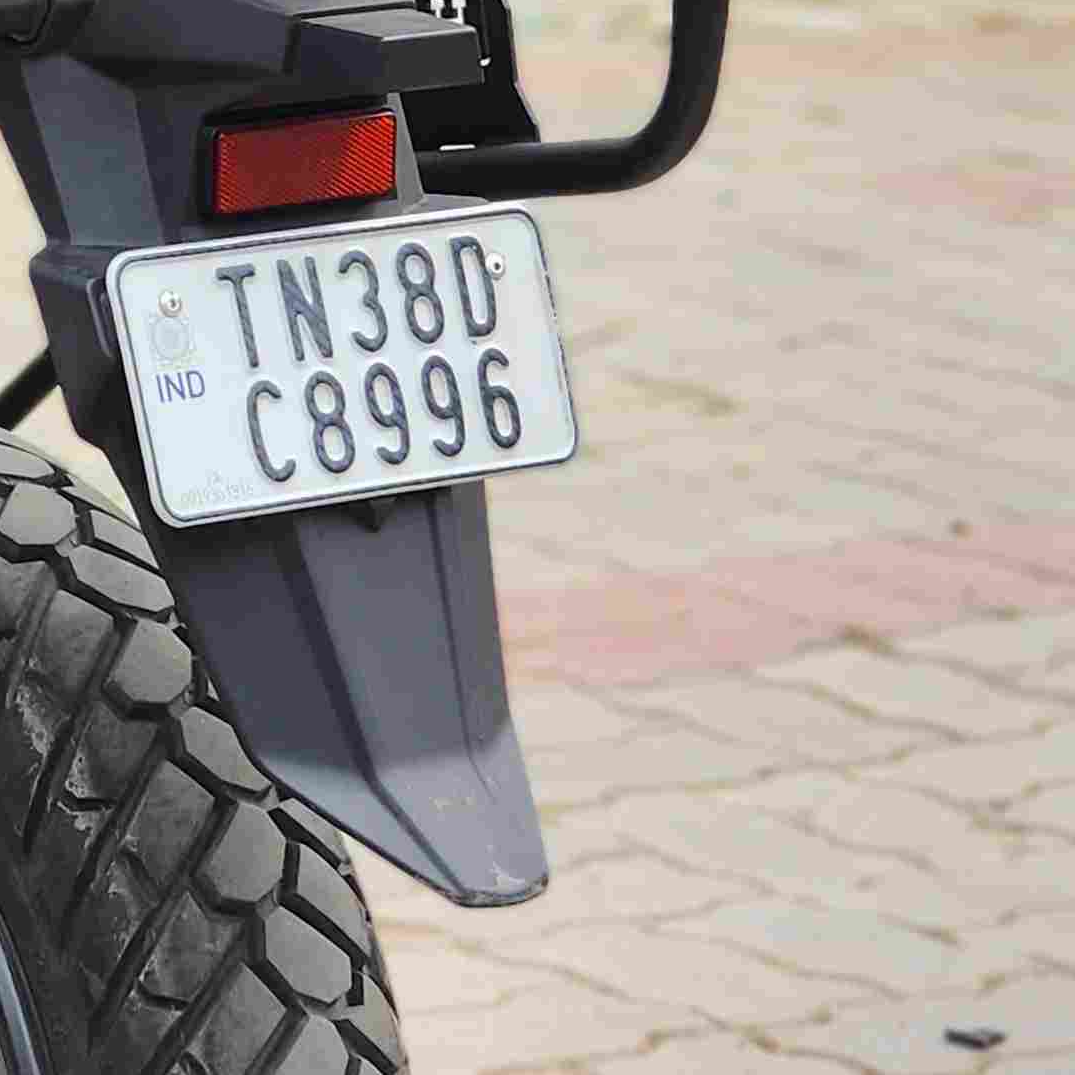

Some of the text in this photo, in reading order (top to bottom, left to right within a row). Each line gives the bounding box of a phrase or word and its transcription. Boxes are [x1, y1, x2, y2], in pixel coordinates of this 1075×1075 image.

[215, 235, 498, 368] TN38D
[156, 370, 205, 403] IND
[246, 348, 522, 483] C8996
